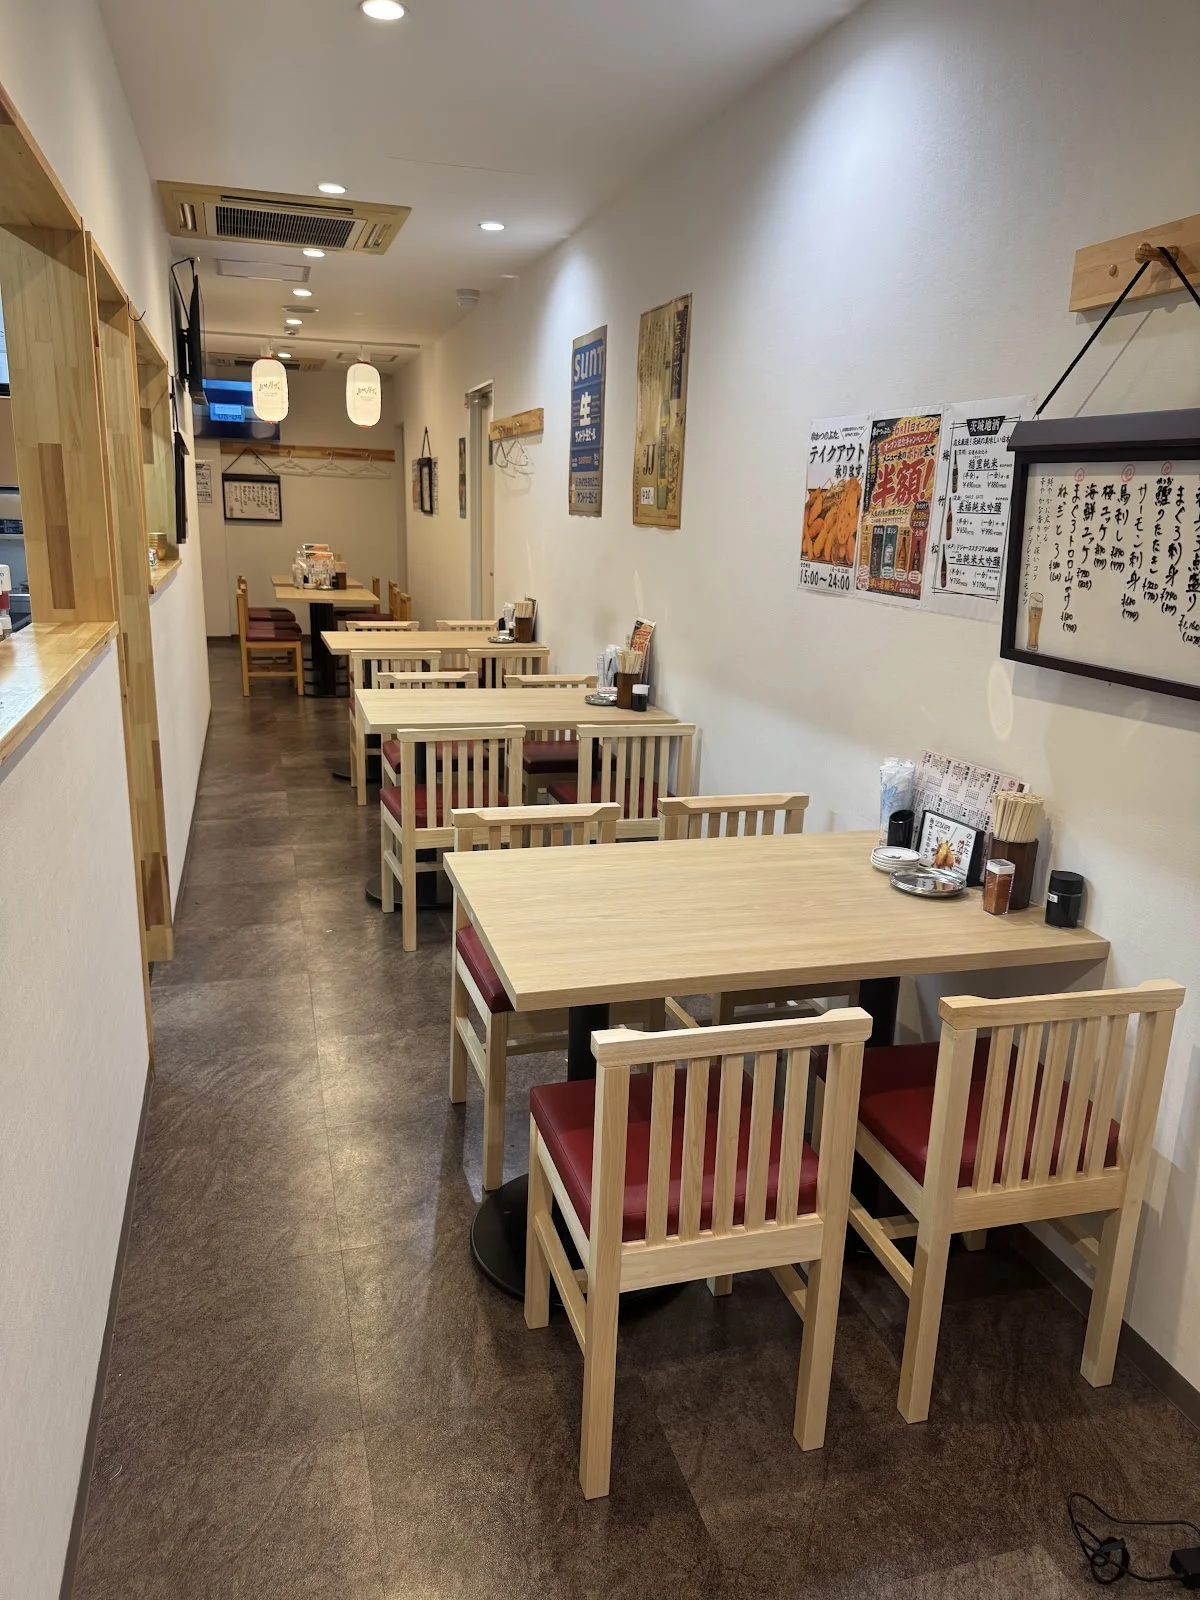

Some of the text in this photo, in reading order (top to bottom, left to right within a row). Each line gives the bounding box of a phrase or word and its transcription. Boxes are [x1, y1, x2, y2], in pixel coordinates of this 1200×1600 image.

[580, 391, 592, 427] 生
[969, 418, 1000, 433] 茨城地酒
[810, 443, 865, 464] テイクアウト
[835, 463, 865, 479] 承ります。
[871, 457, 936, 510] 半額!
[1053, 484, 1069, 560] ねぎとろ
[1081, 483, 1099, 565] 海鮮ユッケ
[1099, 484, 1116, 541] 桜ユッケ
[1114, 484, 1131, 542] 馬刺し
[1126, 483, 1148, 592] サーモン刺身
[1150, 485, 1173, 575] 鰹のたたき
[1165, 485, 1185, 587] まぐろ刺身
[931, 543, 939, 555] 松
[1063, 483, 1081, 611] まぐろトロロ山かけ
